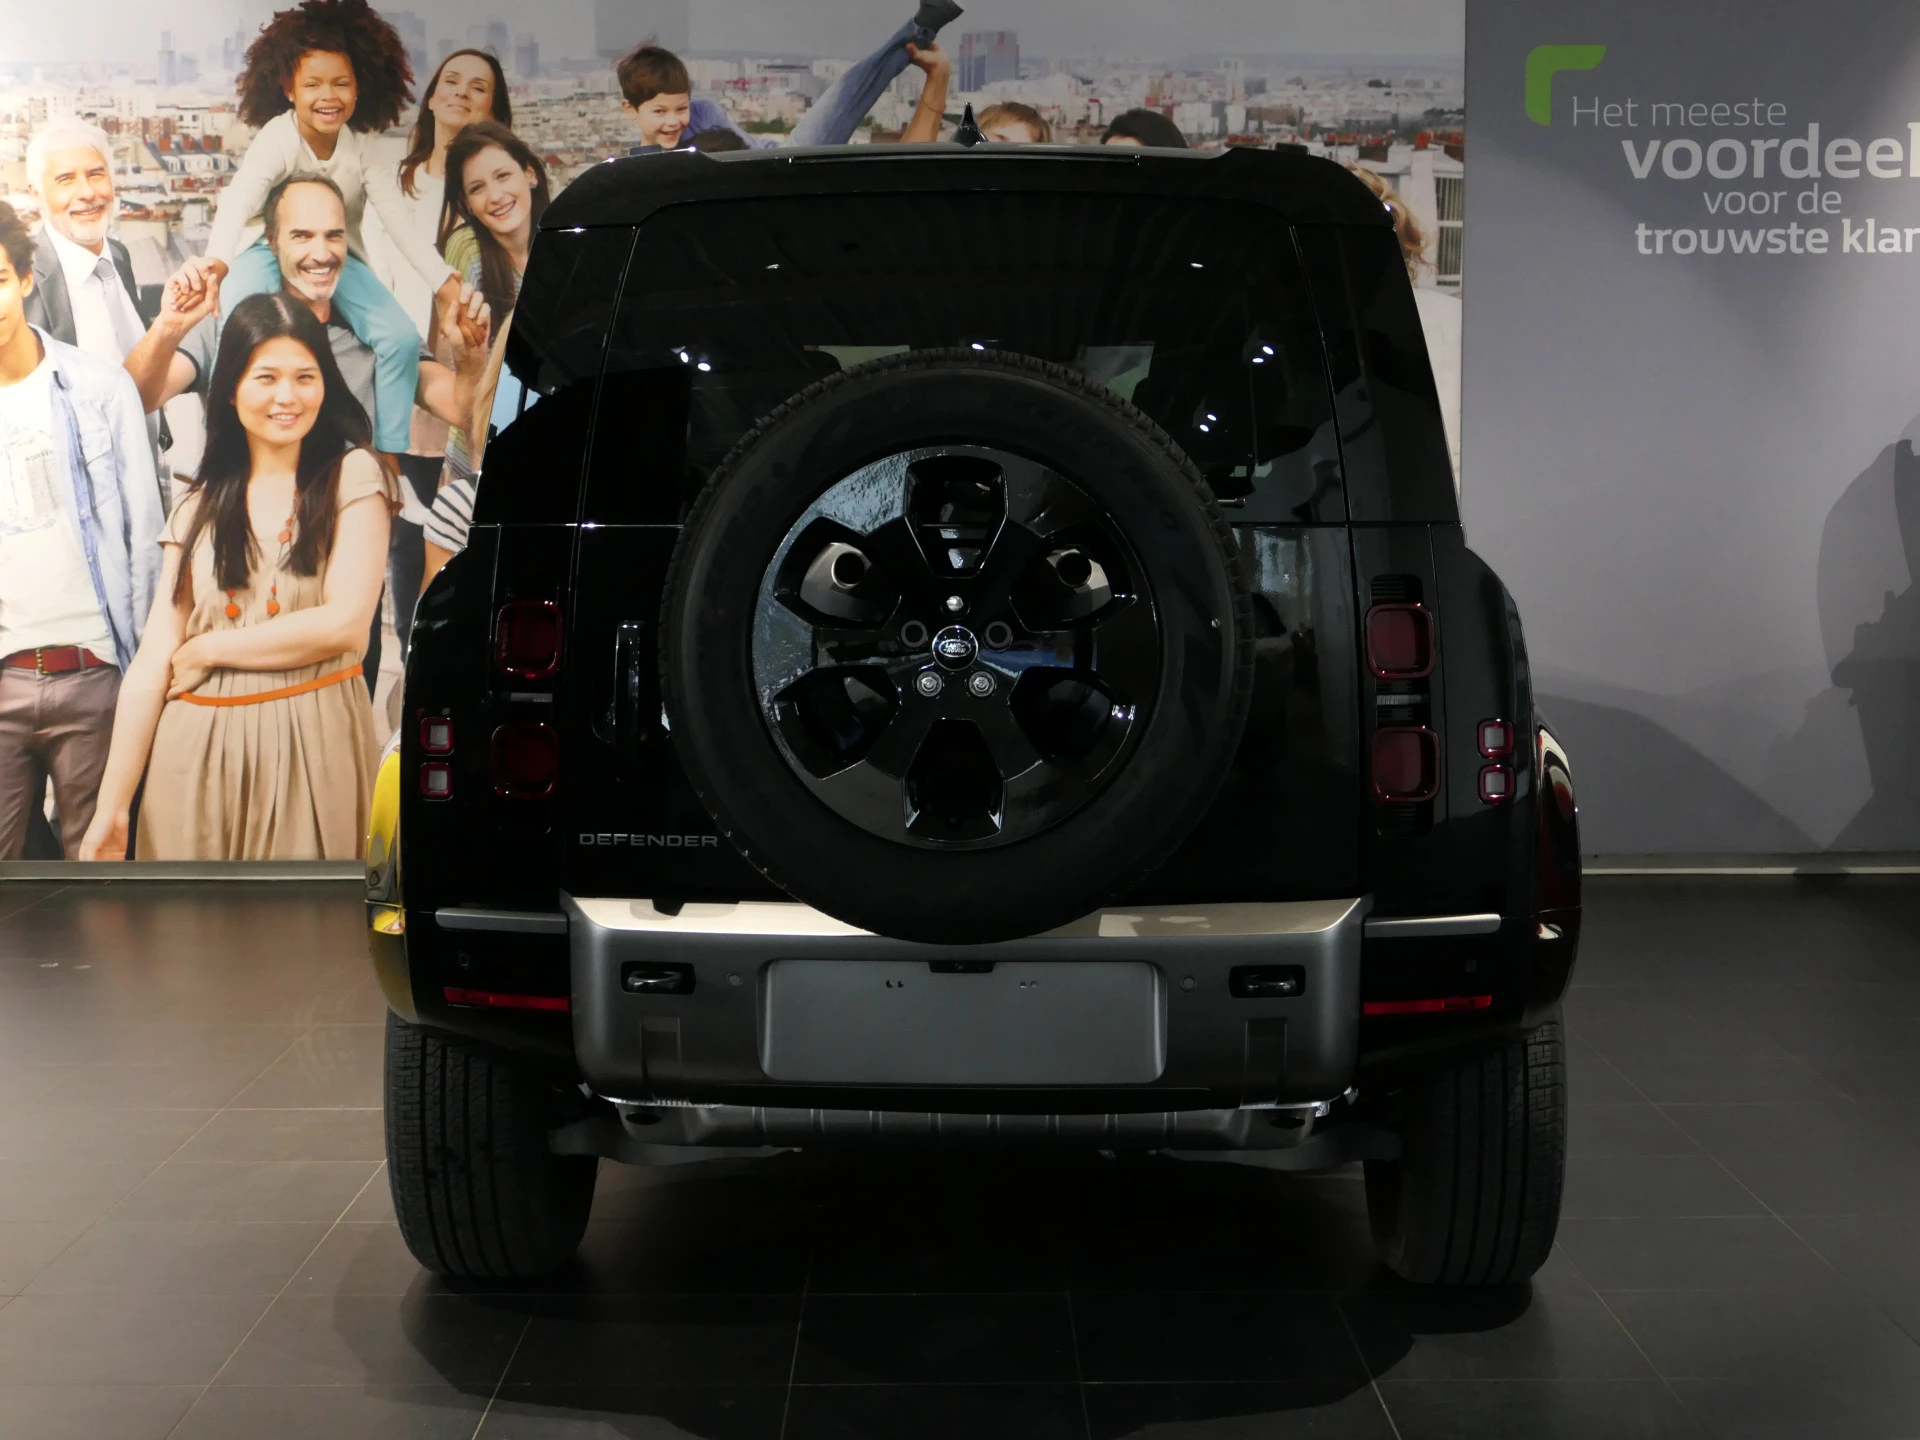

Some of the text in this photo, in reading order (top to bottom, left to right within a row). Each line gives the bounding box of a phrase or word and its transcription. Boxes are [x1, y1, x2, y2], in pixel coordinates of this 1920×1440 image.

[1572, 96, 1787, 126] Het meeste
[1621, 122, 1920, 179] voordeel
[1703, 182, 1842, 214] voor de
[1635, 222, 1829, 255] trouwste
[579, 833, 719, 847] DEFENDER
